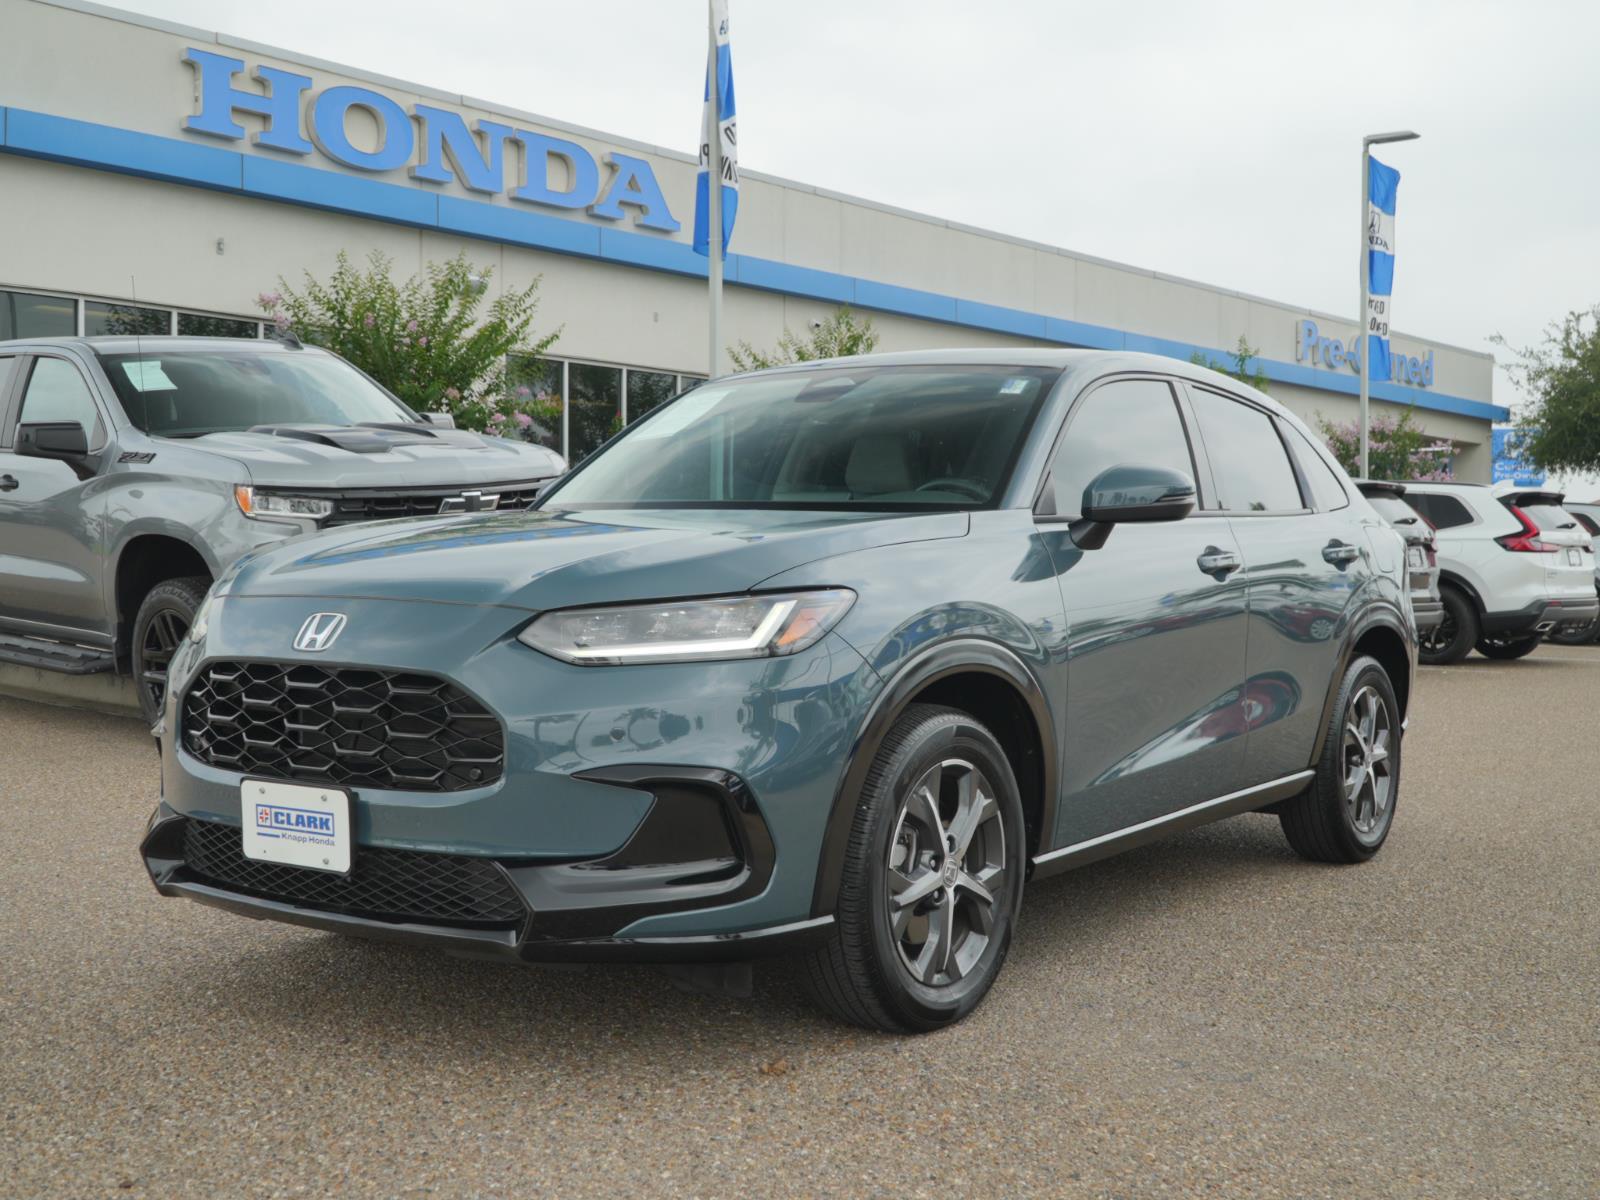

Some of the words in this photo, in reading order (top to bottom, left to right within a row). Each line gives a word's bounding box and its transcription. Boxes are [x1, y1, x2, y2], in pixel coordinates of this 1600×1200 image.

[181, 47, 681, 233] HONDA
[274, 811, 331, 831] CLARK
[281, 832, 307, 844] Knapp
[308, 836, 335, 846] Honda
